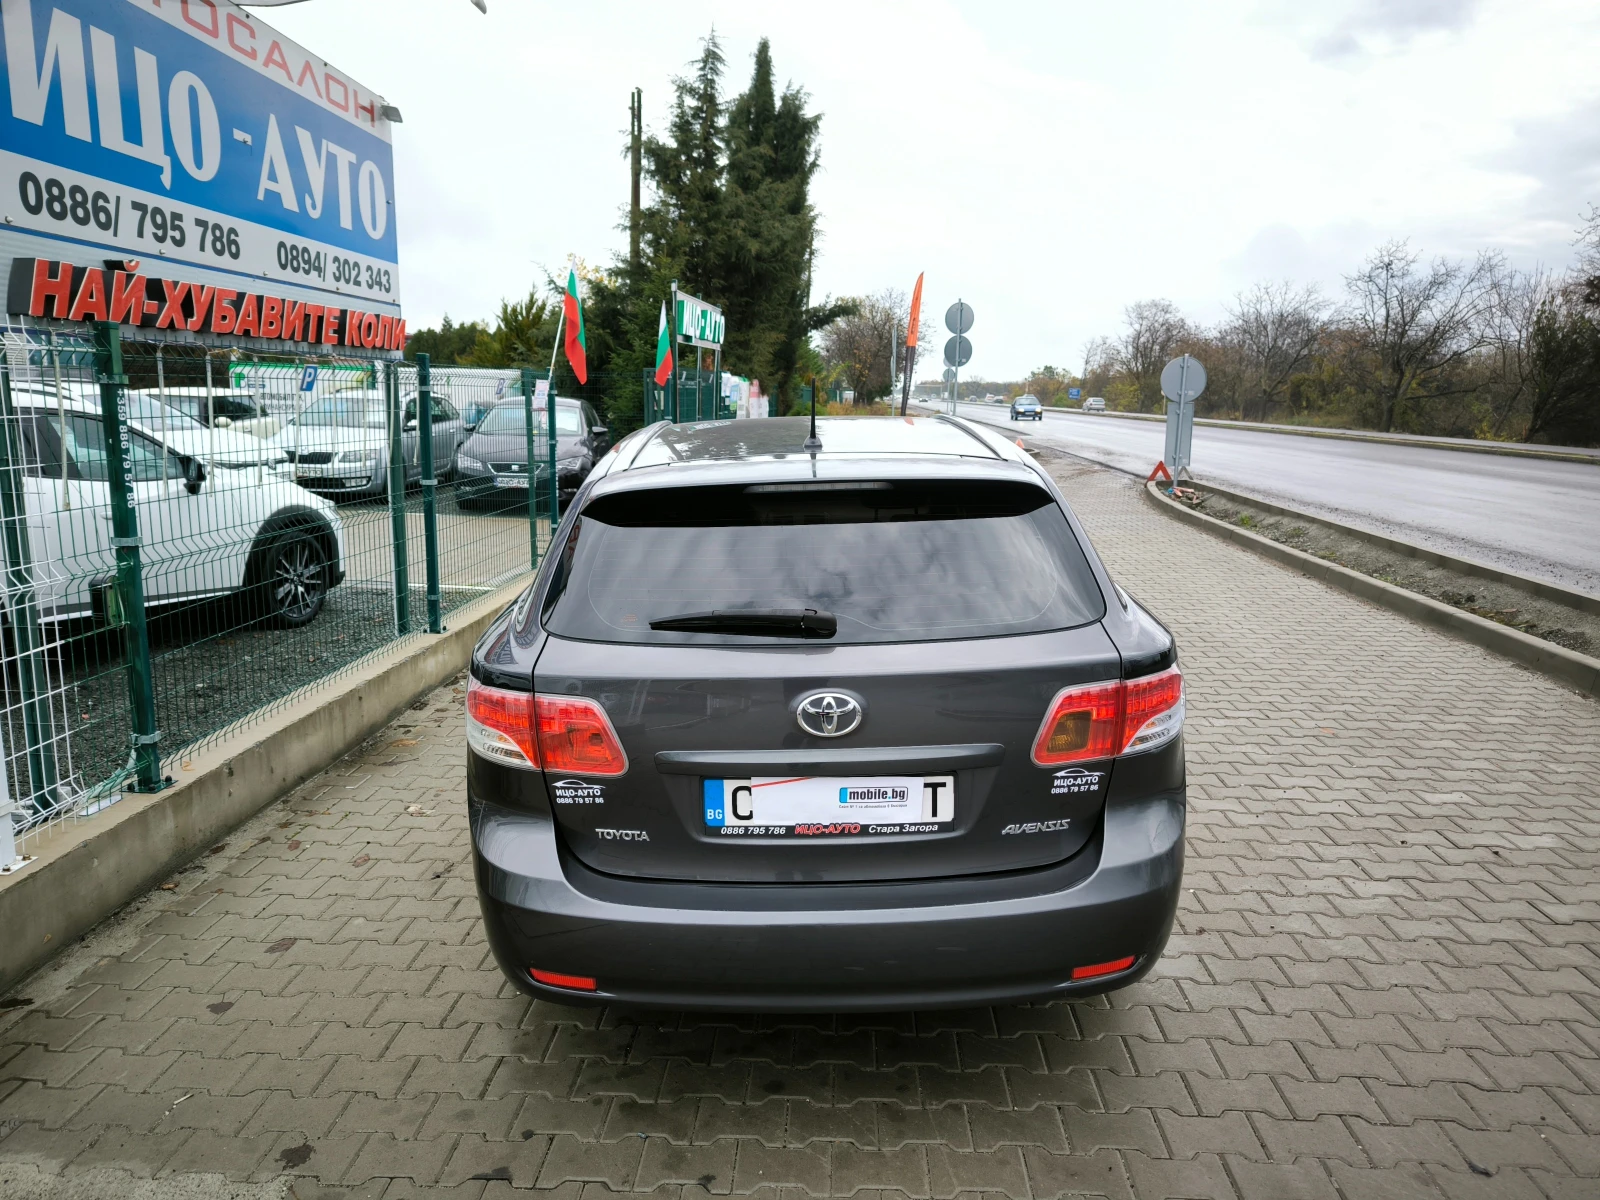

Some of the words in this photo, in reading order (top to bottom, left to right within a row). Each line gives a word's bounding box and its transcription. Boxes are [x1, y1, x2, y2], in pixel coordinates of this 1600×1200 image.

[153, 0, 375, 128] ОСАЛОН
[19, 171, 121, 238] 0886/
[131, 200, 186, 248] 795
[194, 217, 241, 261] 786
[277, 241, 327, 282] 0894/
[332, 255, 362, 288] 302
[366, 264, 392, 294] 343
[29, 258, 341, 345] НАЙ-ХУБАВИТЕ
[345, 309, 407, 351] КОЛИ
[682, 299, 725, 345] ИЦО-АУТО
[302, 368, 315, 389] P
[117, 388, 127, 420] +359
[119, 425, 129, 449] 886
[122, 452, 131, 469] 79
[124, 473, 133, 487] 57
[127, 492, 135, 508] 86
[1053, 776, 1099, 787] ИЦО-АУТО
[555, 788, 601, 797] ИЦО-АУТО
[849, 788, 905, 801] mobile.bg
[923, 782, 947, 818] T
[707, 809, 723, 820] BG
[595, 828, 650, 841] TOYOTA
[720, 826, 745, 835] 0886
[747, 826, 766, 835] 795
[768, 826, 786, 835] 786
[794, 822, 861, 836] ИЦО-АУТО
[868, 825, 900, 834] Стара
[902, 824, 938, 832] Загора
[1001, 818, 1071, 835] AVENSIS
